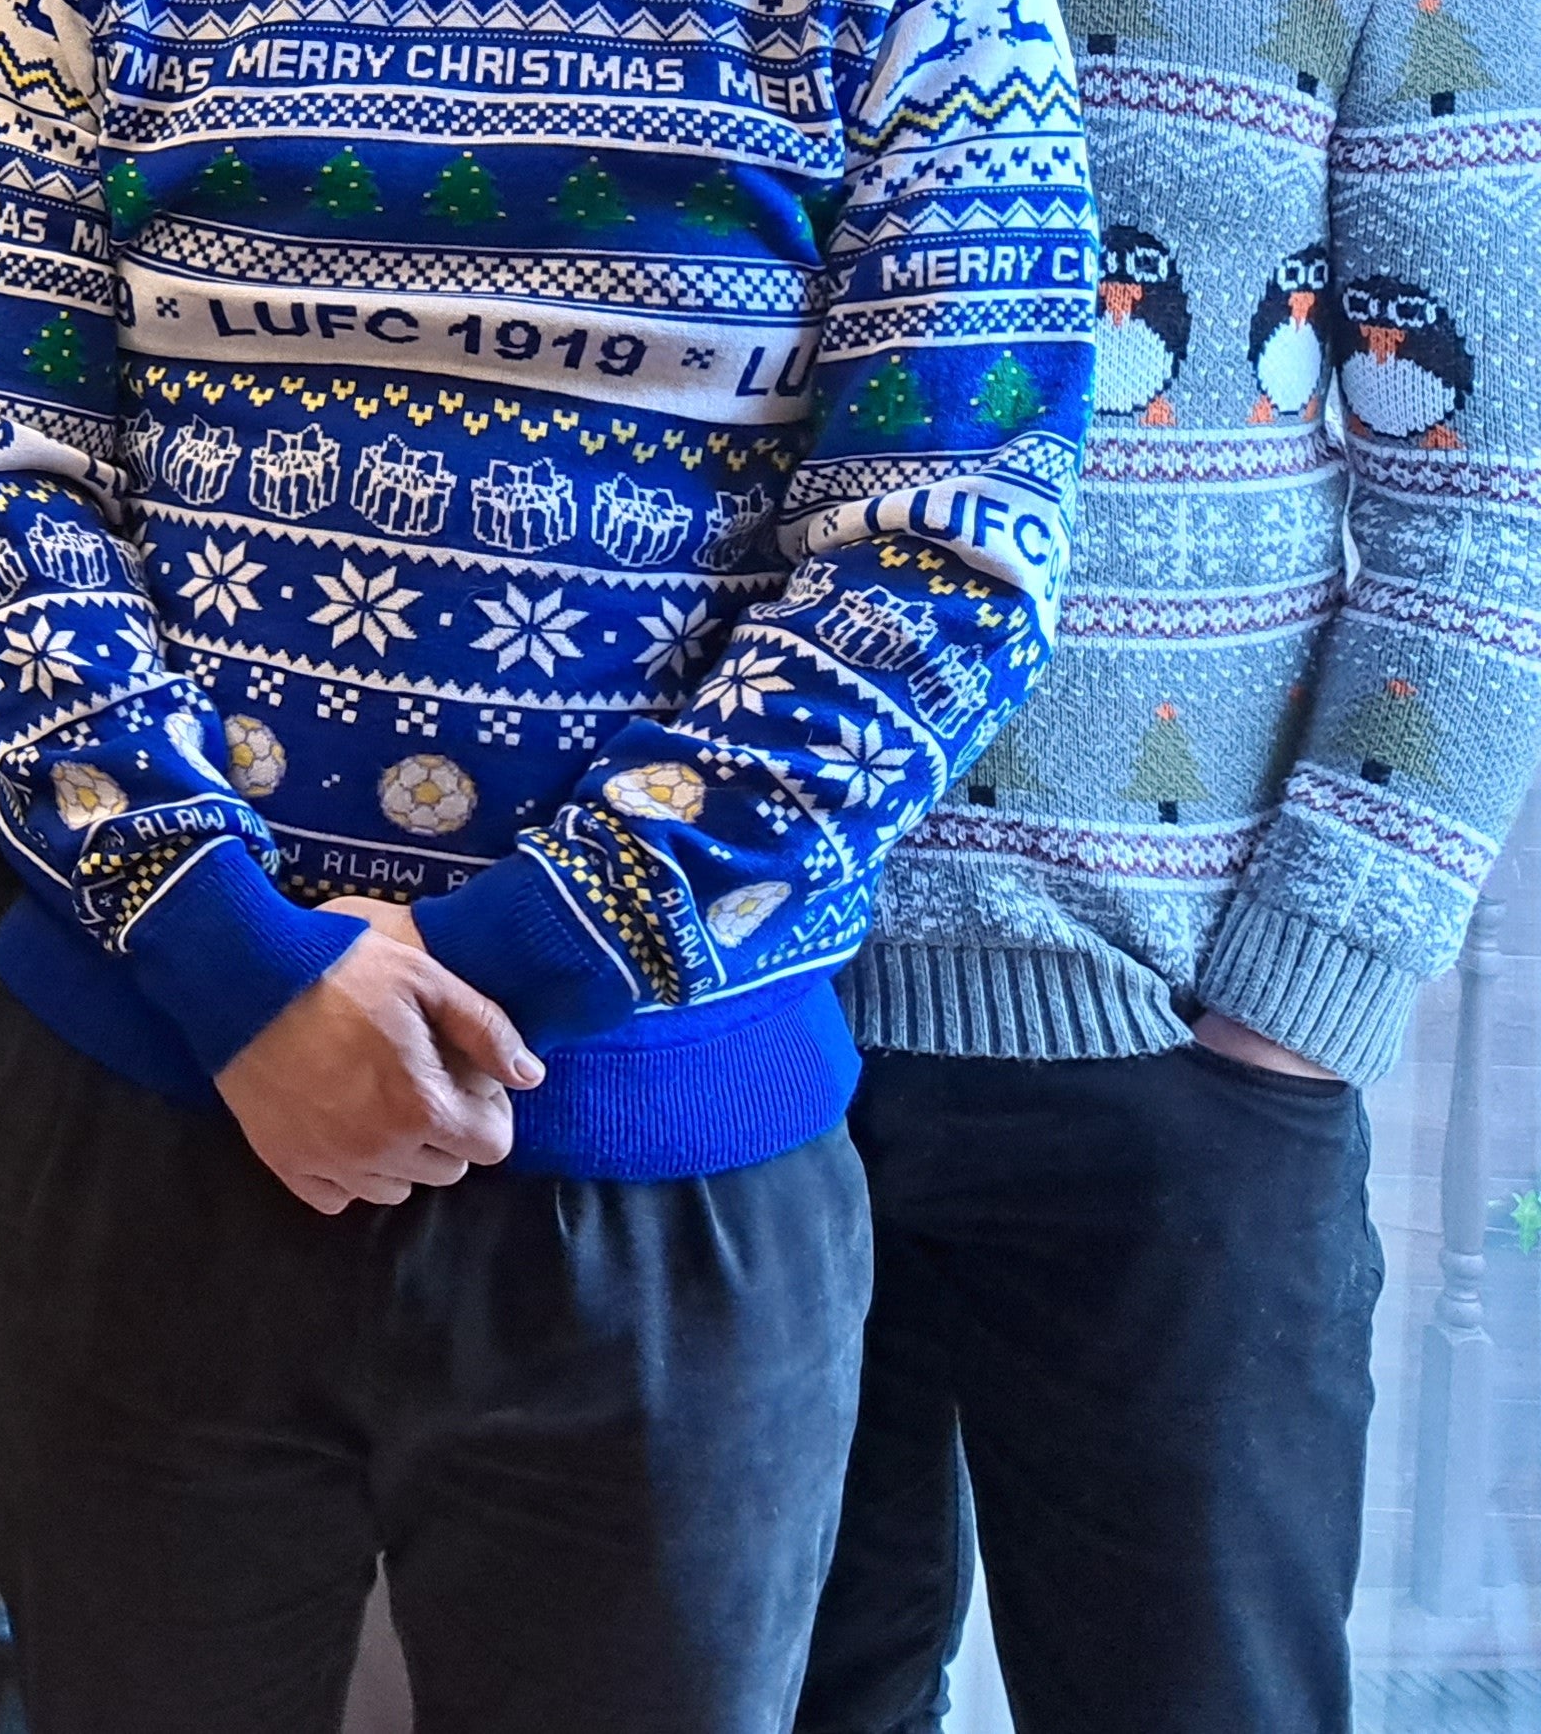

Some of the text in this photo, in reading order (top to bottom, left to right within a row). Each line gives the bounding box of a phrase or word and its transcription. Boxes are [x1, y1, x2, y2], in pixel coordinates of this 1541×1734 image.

[226, 38, 396, 81] MERRY
[406, 43, 686, 93] CHRISTMAS
[881, 244, 1043, 293] MERRY
[209, 298, 420, 344] LUFC
[447, 313, 648, 378] 1919
[132, 806, 227, 841] ALAW
[323, 850, 425, 887] ALAW
[657, 886, 708, 970] ALAW
